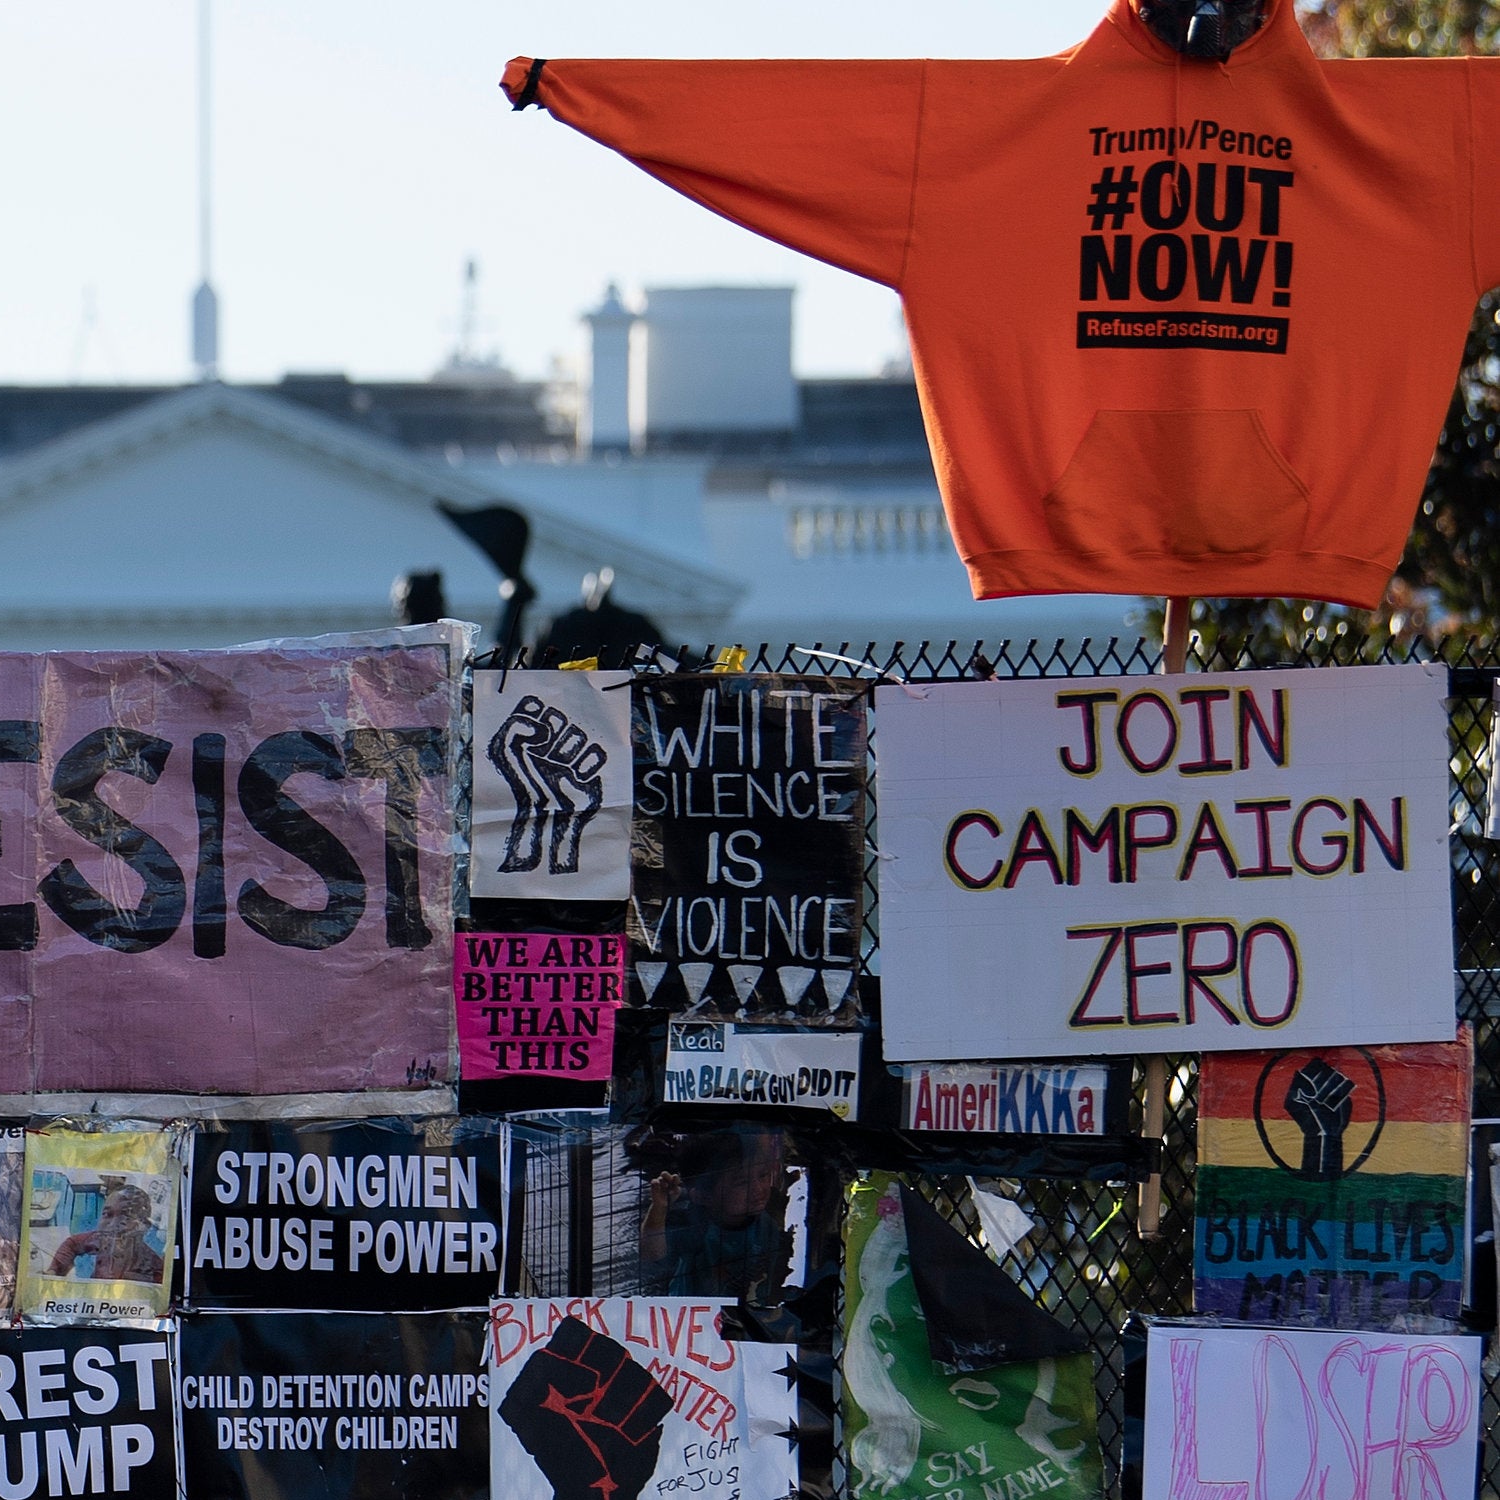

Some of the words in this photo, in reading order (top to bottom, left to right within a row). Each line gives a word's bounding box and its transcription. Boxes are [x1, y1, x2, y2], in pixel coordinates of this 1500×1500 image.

[1089, 120, 1292, 160] Trump/Pence
[1087, 160, 1294, 236] #OUT
[1079, 233, 1294, 308] NOW!
[1087, 319, 1279, 345] RefuseFascism.org
[646, 688, 856, 768] WHITE
[1056, 688, 1289, 778] JOIN
[637, 772, 853, 821] SILENCE
[707, 829, 763, 887] IS
[945, 796, 1410, 891] CAMPAIGN
[464, 938, 528, 967] WE
[538, 938, 619, 967] ARE
[631, 896, 855, 963] VIOLENCE
[462, 973, 620, 1002] BETTER
[1065, 918, 1299, 1029] ZERO
[482, 1008, 600, 1036] THAN
[672, 1025, 724, 1050] Yeah
[490, 1042, 590, 1070] THIS
[667, 1068, 696, 1097] THE
[699, 1067, 768, 1102] BLACK
[768, 1071, 797, 1104] GUY
[797, 1068, 831, 1097] DID
[832, 1071, 855, 1097] IT
[915, 1069, 1094, 1132] AmeriKKKa
[214, 1152, 477, 1208] STRONGMEN
[194, 1216, 334, 1271] ABUSE
[348, 1218, 496, 1273] POWER
[182, 1375, 255, 1410] CHILD
[262, 1375, 400, 1409] DETENTION
[409, 1375, 489, 1408] CAMPS
[217, 1416, 324, 1451] DESTROY
[335, 1416, 457, 1450] CHILDREN
[925, 1442, 996, 1488] SAY
